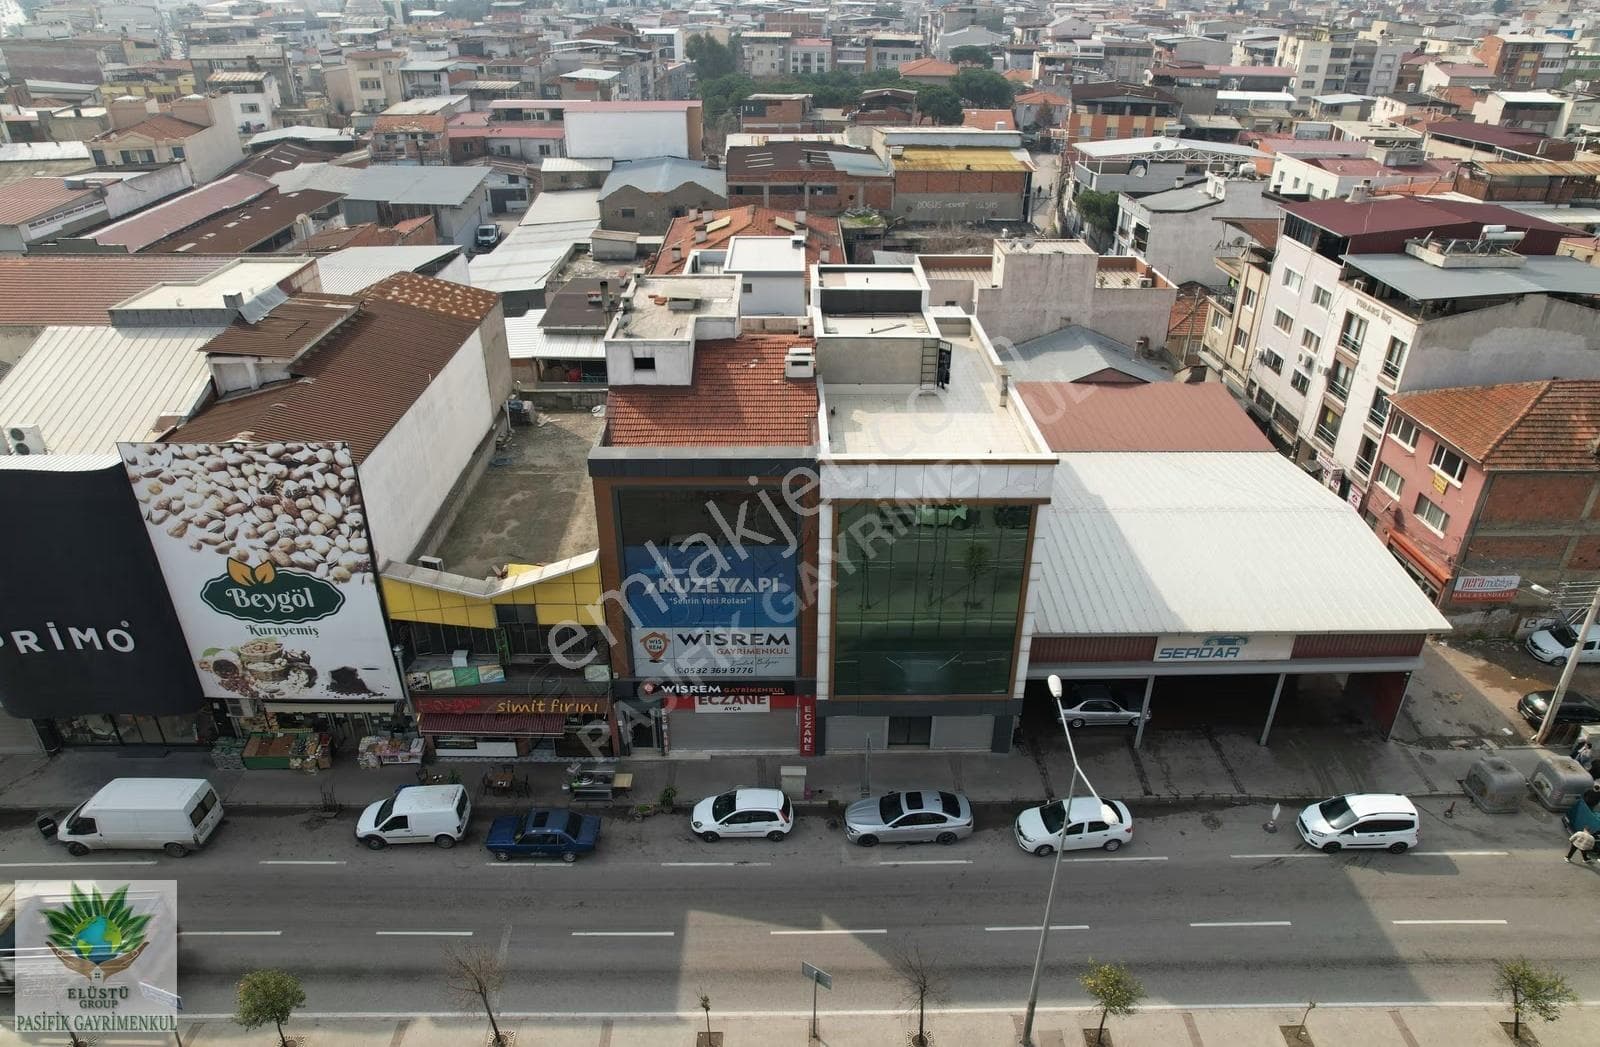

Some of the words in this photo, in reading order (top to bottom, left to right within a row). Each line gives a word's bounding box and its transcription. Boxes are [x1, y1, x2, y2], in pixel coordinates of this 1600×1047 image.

[225, 587, 315, 613] Beygöl
[0, 621, 135, 654] RİMO
[246, 624, 320, 638] Kuruyemiş
[497, 699, 546, 713] simit
[698, 695, 767, 705] ECZANE
[804, 705, 813, 751] ECZANE
